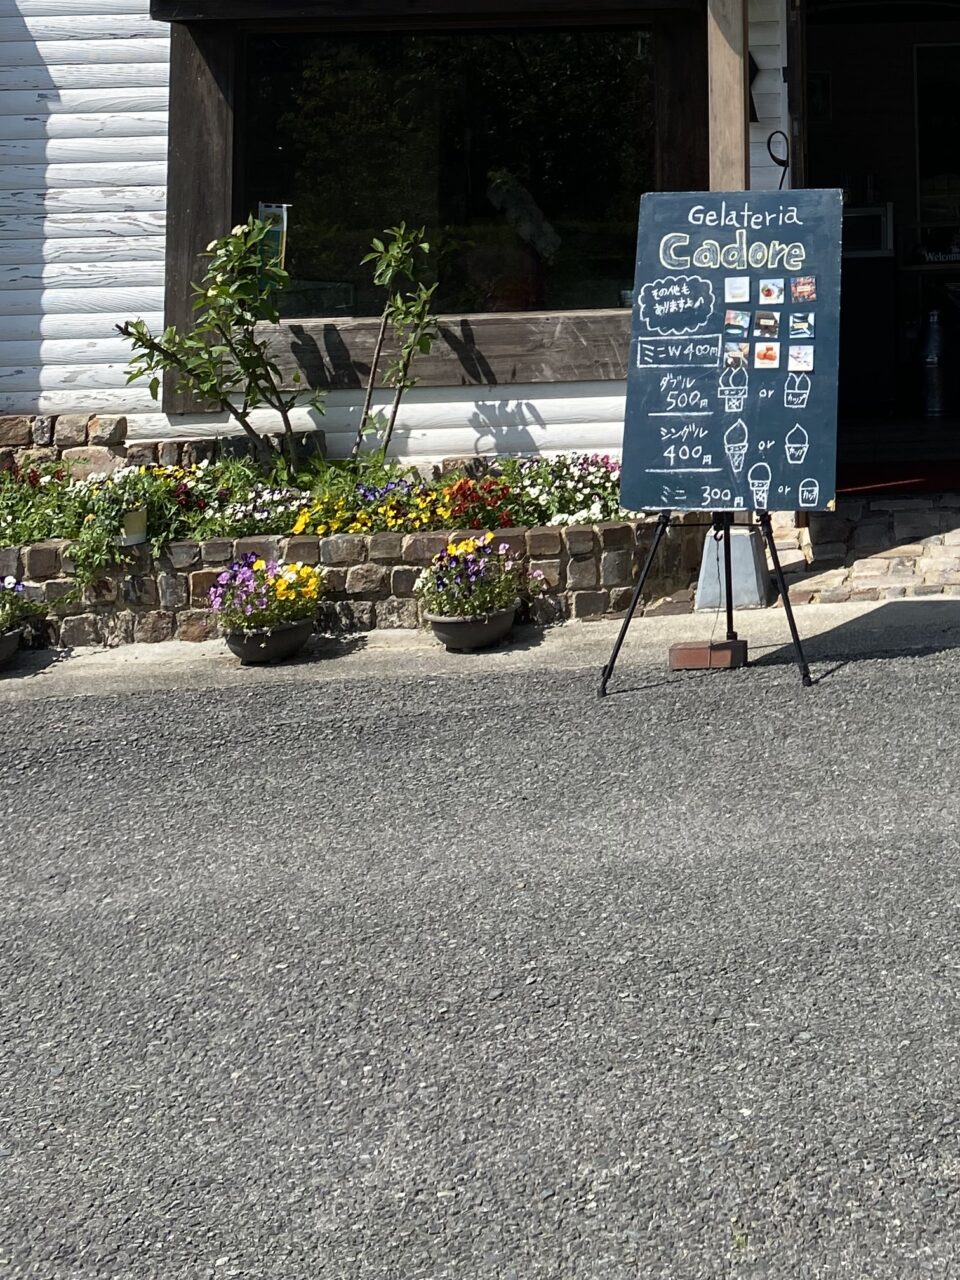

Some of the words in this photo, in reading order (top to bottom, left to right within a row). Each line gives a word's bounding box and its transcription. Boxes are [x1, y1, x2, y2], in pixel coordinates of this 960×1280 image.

[688, 201, 803, 229] Gelateria
[659, 229, 806, 270] Cadore
[652, 283, 690, 300] その他も
[659, 373, 697, 391] ダブル
[666, 391, 708, 410] 500円
[759, 389, 775, 398] or
[660, 423, 708, 442] シングル
[758, 439, 776, 450] or
[663, 446, 712, 466] 400円
[661, 486, 687, 503] ミニ
[700, 485, 744, 507] 300円
[778, 486, 791, 495] or
